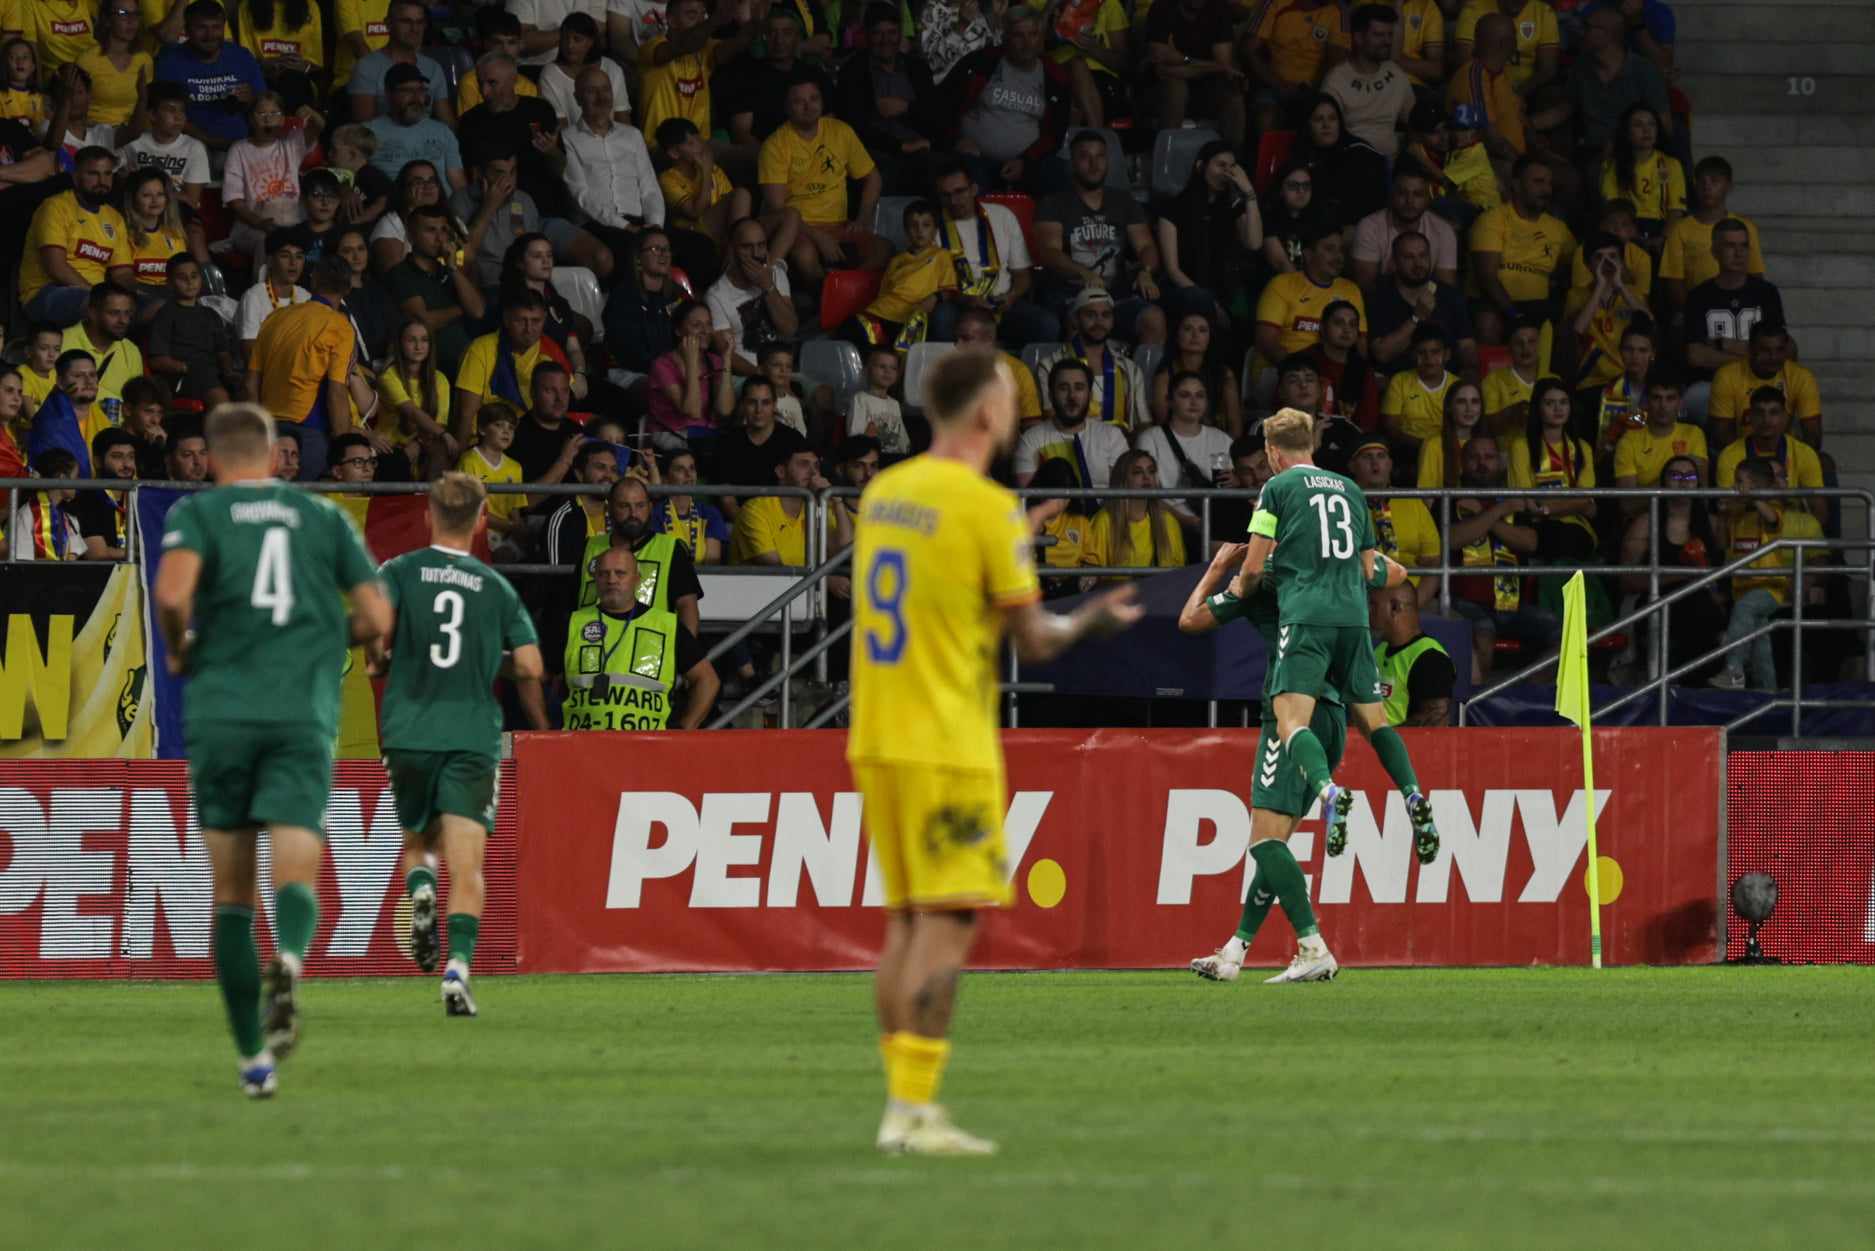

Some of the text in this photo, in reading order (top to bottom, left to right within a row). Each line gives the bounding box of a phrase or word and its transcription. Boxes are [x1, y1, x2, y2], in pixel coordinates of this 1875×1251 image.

[1785, 76, 1816, 96] 10
[1073, 224, 1117, 241] FUTURE
[137, 262, 167, 273] PEN
[1308, 493, 1355, 560] 13
[250, 526, 297, 627] 4
[865, 547, 908, 665] 9
[430, 590, 465, 669] 3
